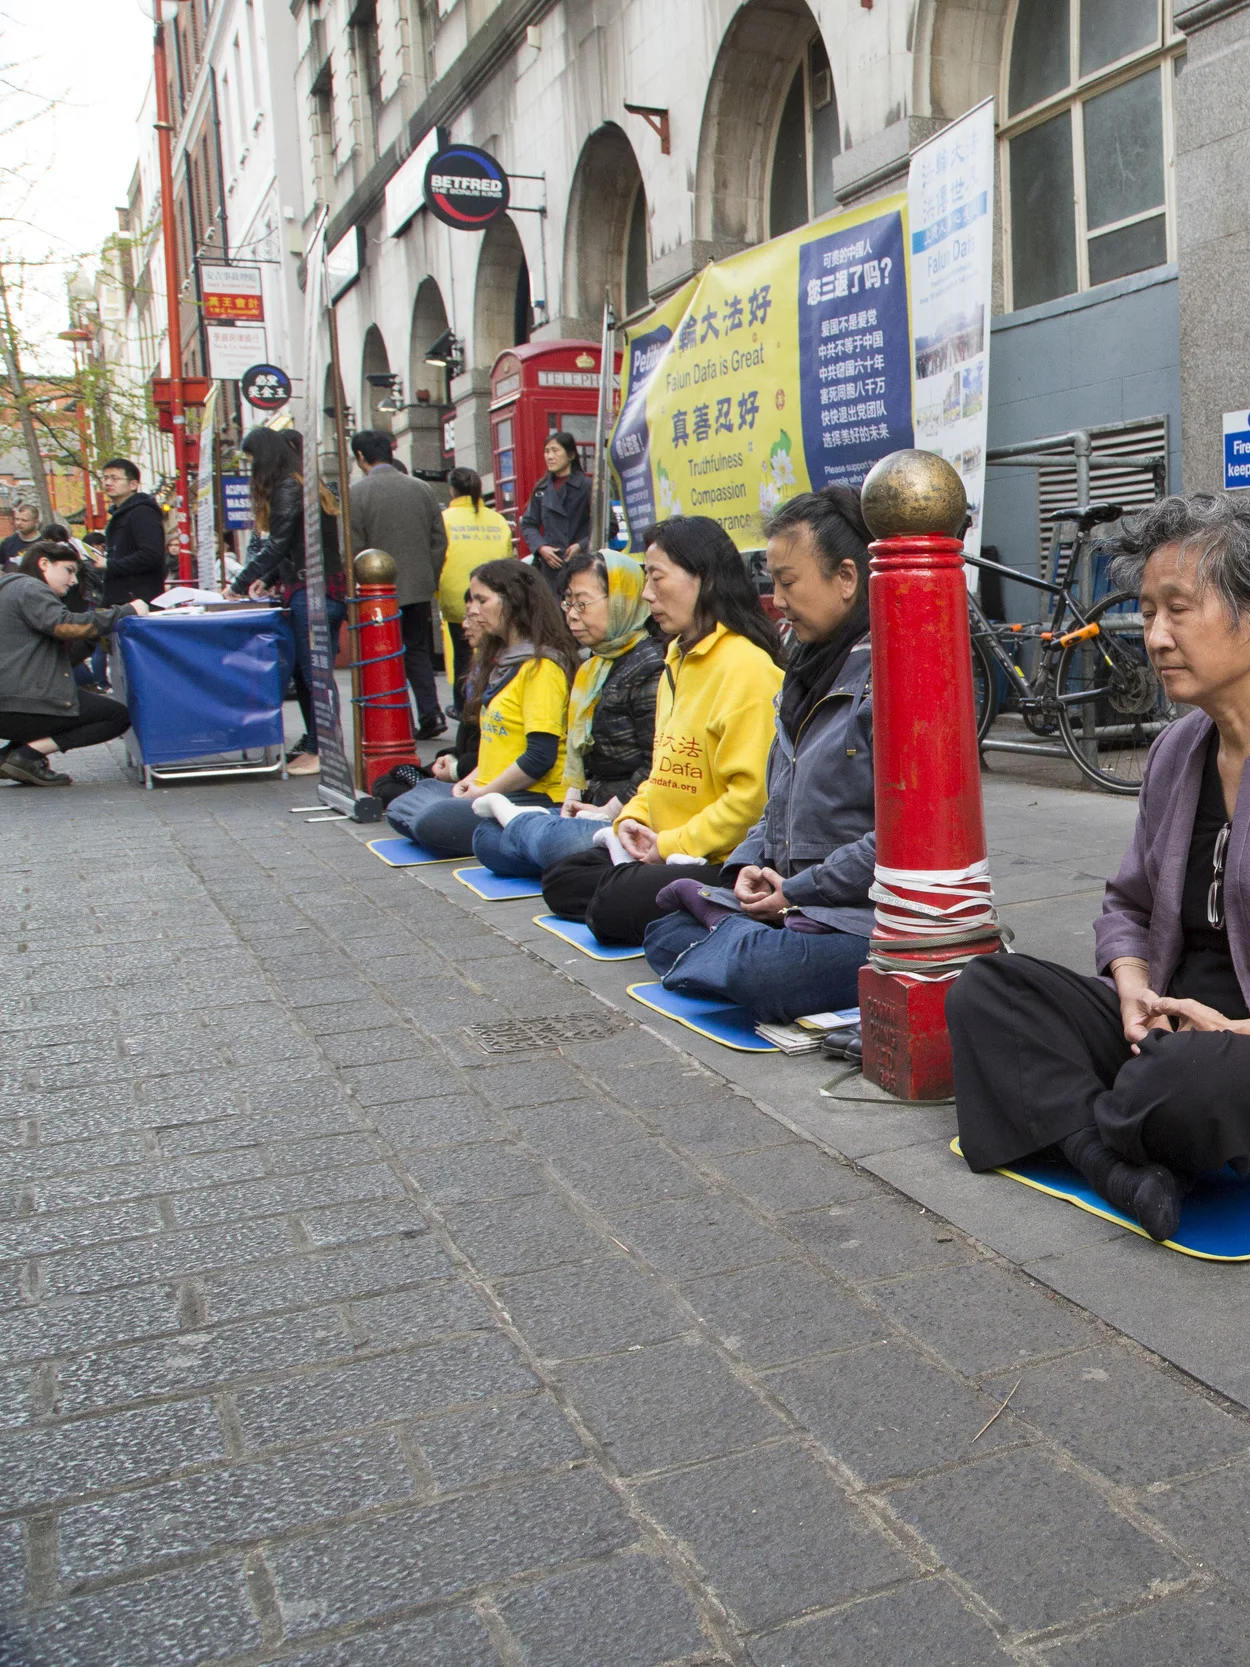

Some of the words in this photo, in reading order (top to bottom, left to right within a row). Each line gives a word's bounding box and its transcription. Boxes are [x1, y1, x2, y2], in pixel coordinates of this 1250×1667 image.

[431, 174, 503, 192] BETFRED
[431, 186, 448, 195] THE
[449, 188, 480, 196] BONUS
[481, 190, 503, 198] KING
[823, 238, 872, 268] 可贵的中国人
[927, 250, 950, 277] Falun
[676, 284, 772, 351] 輪大法好
[821, 308, 877, 338] 爱国不是爱党
[818, 330, 884, 361] 中共不等于中国
[544, 371, 621, 387] TELEPHN
[666, 370, 691, 394] Falun
[693, 358, 717, 384] Dafa
[720, 356, 728, 376] is
[731, 342, 765, 372] Great
[820, 377, 886, 405] 害死同胞八千万
[672, 390, 760, 449] 真善忍好
[821, 400, 887, 427] 快快退出党团队
[822, 422, 890, 448] 选择美好的未来
[688, 451, 743, 477] Truthfulness
[824, 464, 846, 475] Please
[846, 460, 868, 473] support
[225, 484, 250, 495] ACUPUN
[849, 475, 863, 484] who
[227, 498, 252, 508] MASS
[690, 480, 746, 507] Compassion
[714, 513, 751, 531] arance
[660, 756, 703, 780] Dafa
[650, 778, 697, 794] ndafa.org
